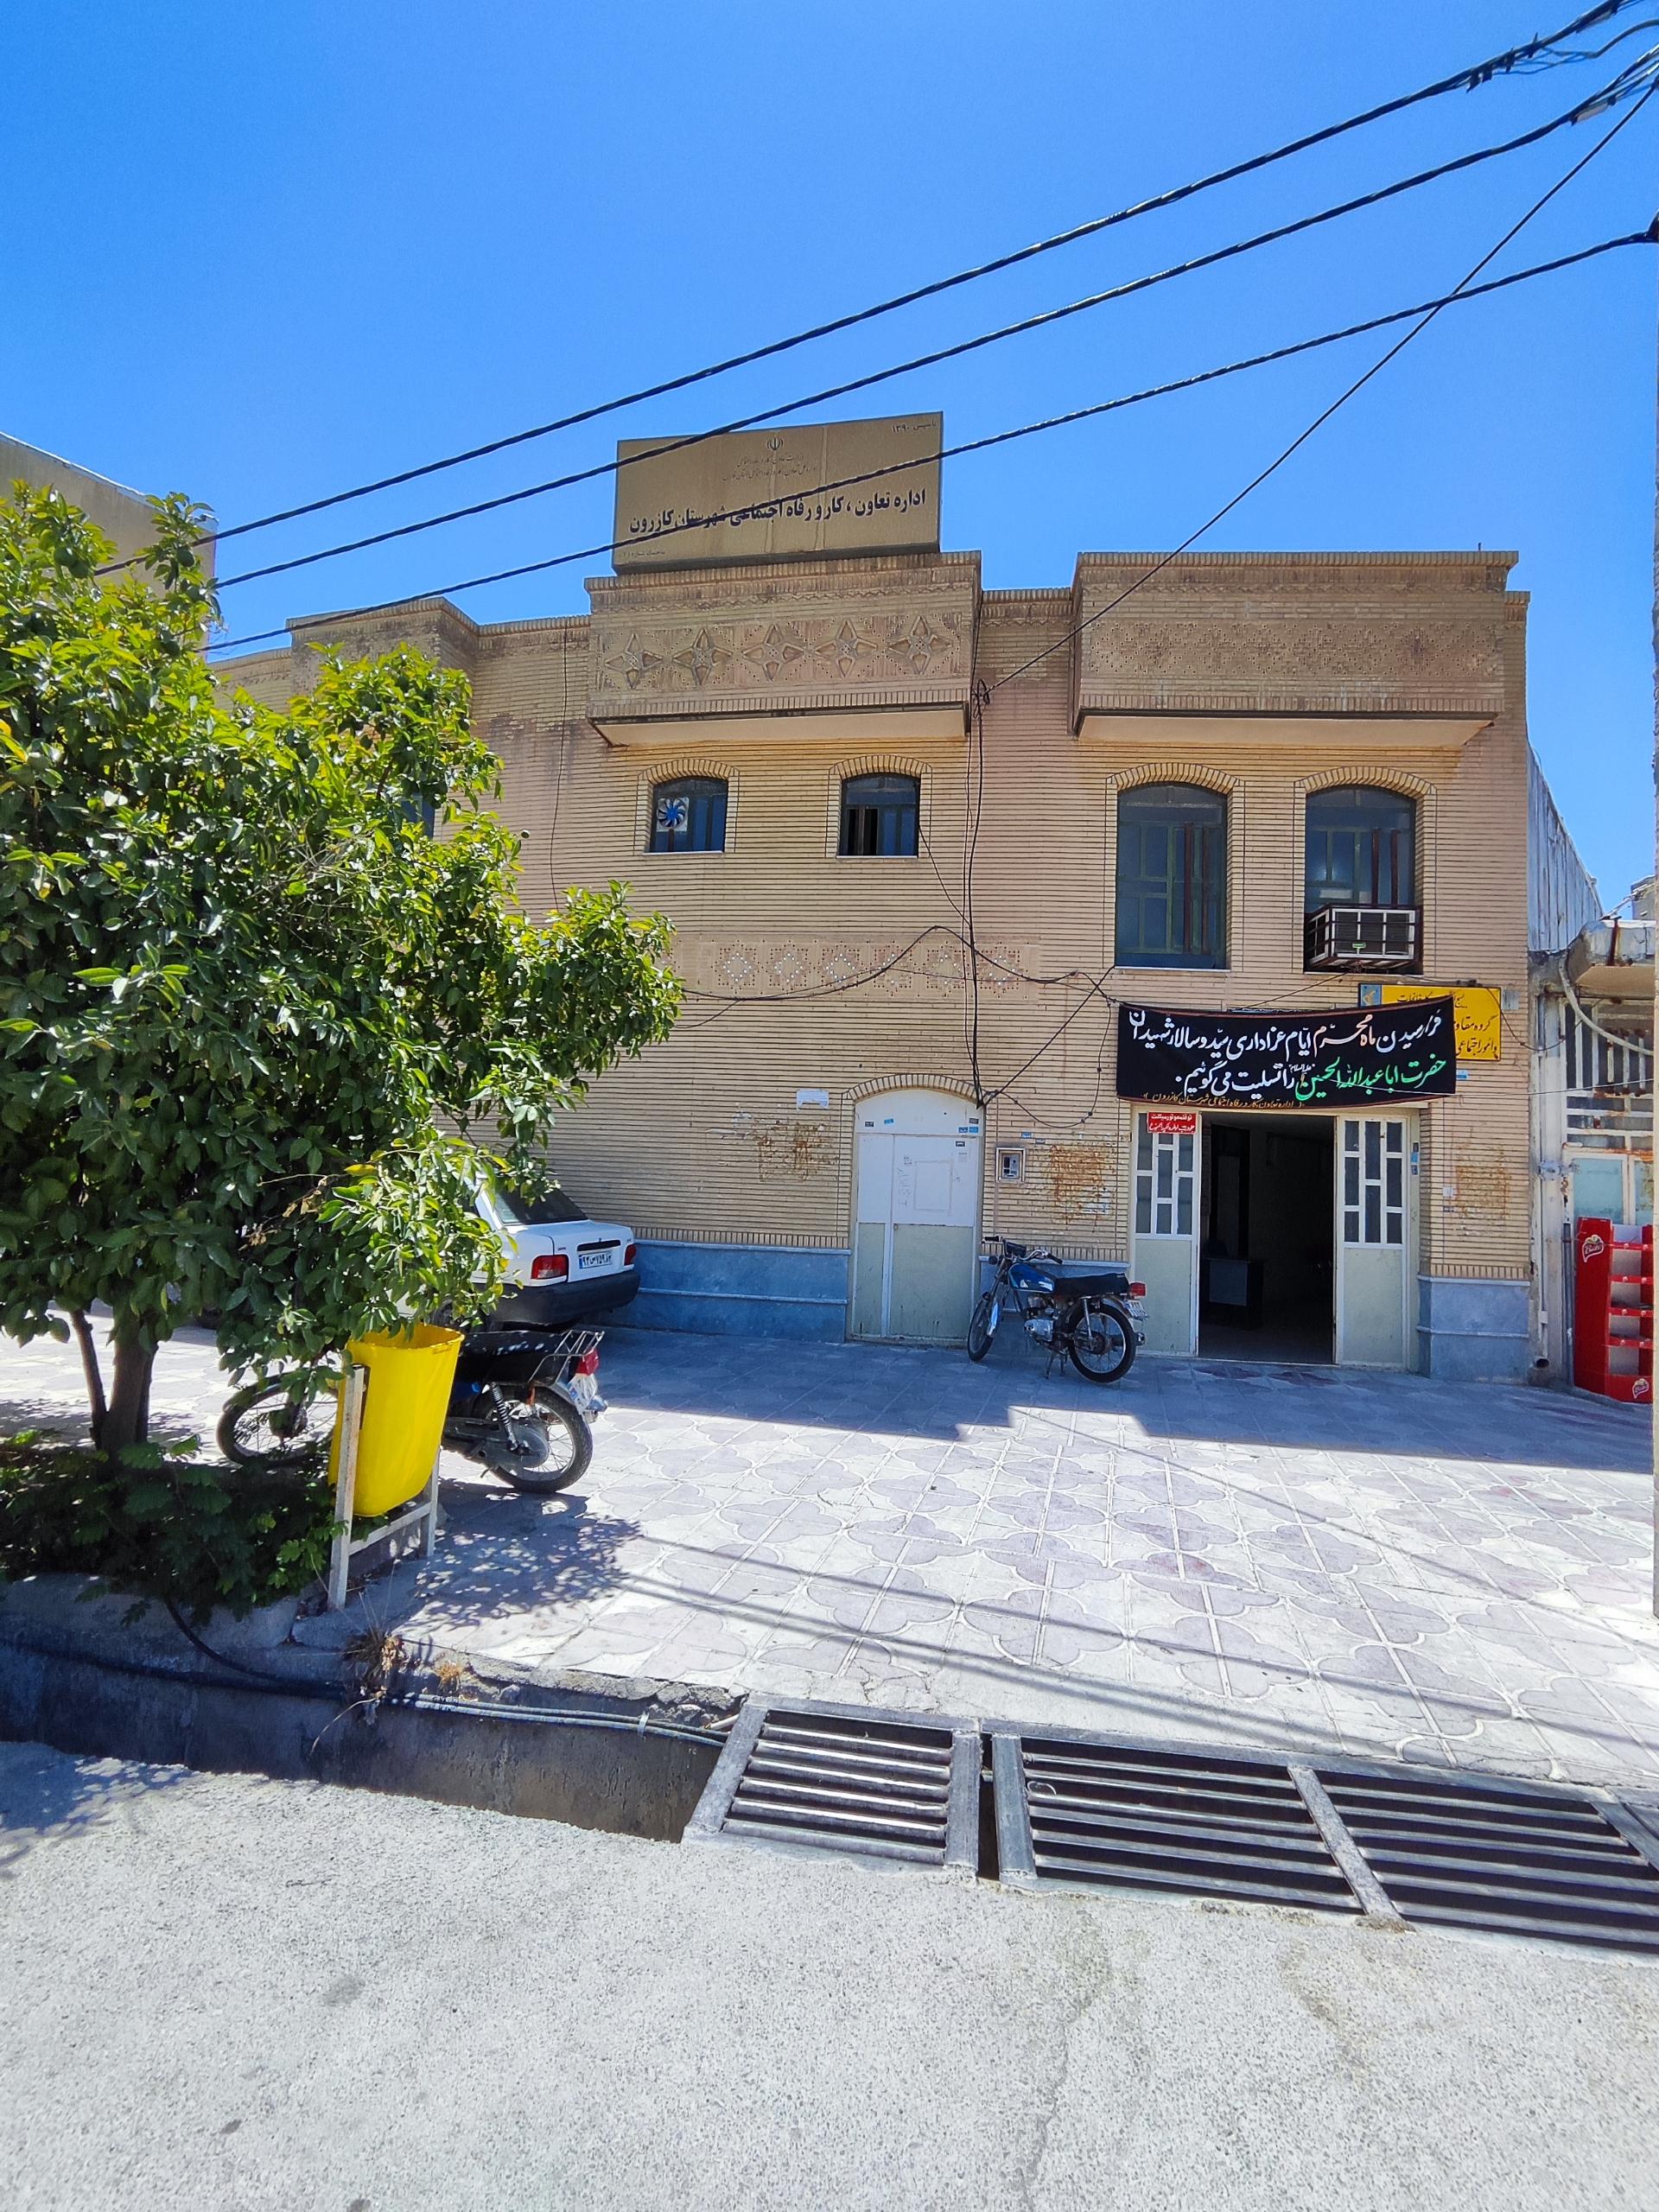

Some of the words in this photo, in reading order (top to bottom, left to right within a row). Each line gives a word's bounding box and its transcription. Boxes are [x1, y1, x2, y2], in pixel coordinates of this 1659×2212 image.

[786, 497, 811, 521] رفاه
[824, 495, 844, 519] کار
[893, 487, 926, 512] اداره
[630, 509, 674, 533] کازرون
[675, 505, 727, 529] شهرستان
[729, 500, 783, 526] اجتماعی
[815, 504, 823, 520] و
[1128, 1009, 1175, 1049] شهیدان
[1166, 1026, 1199, 1049] سالار
[1360, 1026, 1377, 1047] ماه
[1198, 1036, 1208, 1049] و
[1225, 1027, 1287, 1061] عزاداری
[1454, 1038, 1482, 1057] اجتماعی
[1230, 1062, 1284, 1101] تسلیت
[1282, 1067, 1294, 1090] را
[1294, 1056, 1341, 1102] الحسین
[1401, 1052, 1447, 1090] حضرت
[1211, 1071, 1231, 1096] می
[1152, 1091, 1184, 1103] کازرون
